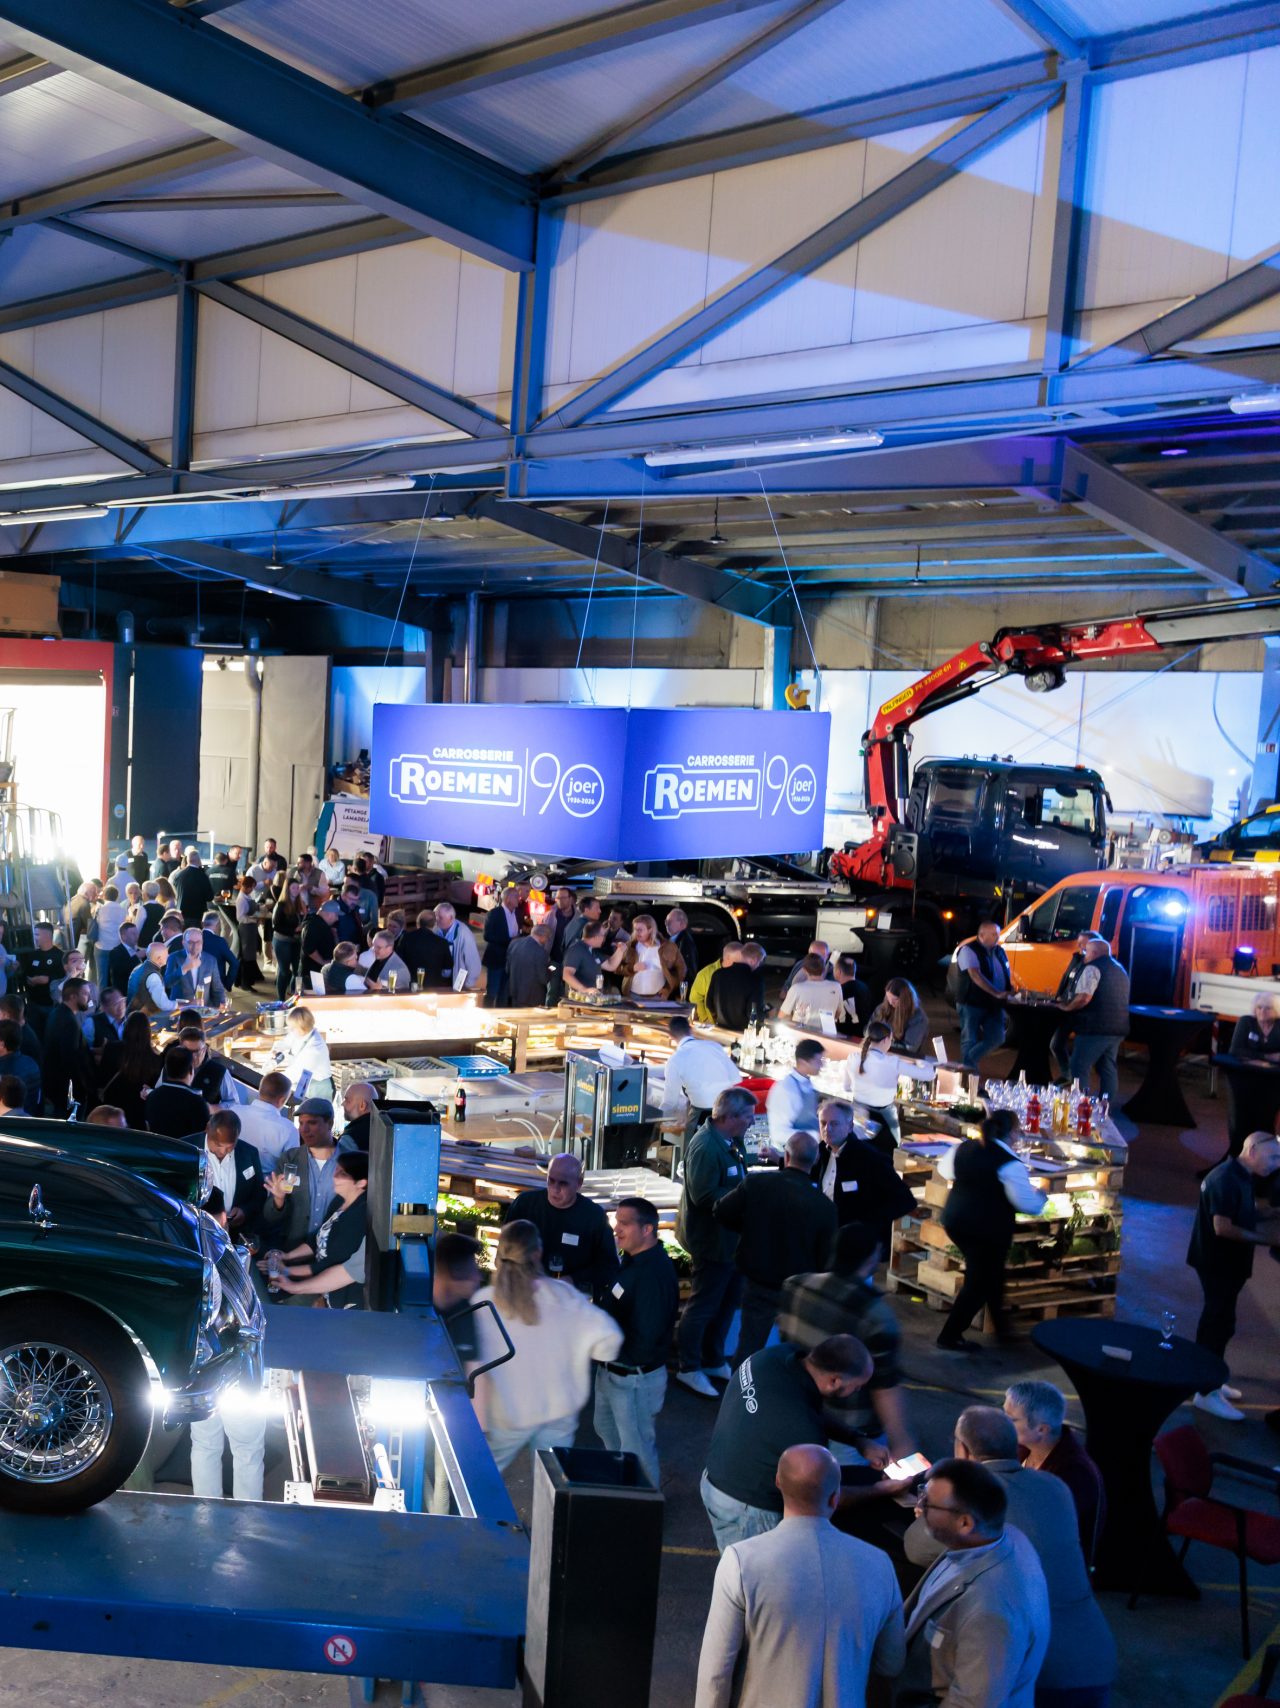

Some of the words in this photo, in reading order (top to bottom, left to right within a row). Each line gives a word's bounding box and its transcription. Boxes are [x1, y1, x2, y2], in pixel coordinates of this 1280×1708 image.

[433, 747, 513, 762] CARROSSERIE
[687, 754, 755, 766] CARROSSERIE
[566, 777, 598, 797] joer
[791, 777, 813, 796] joer
[612, 1104, 638, 1113] simon
